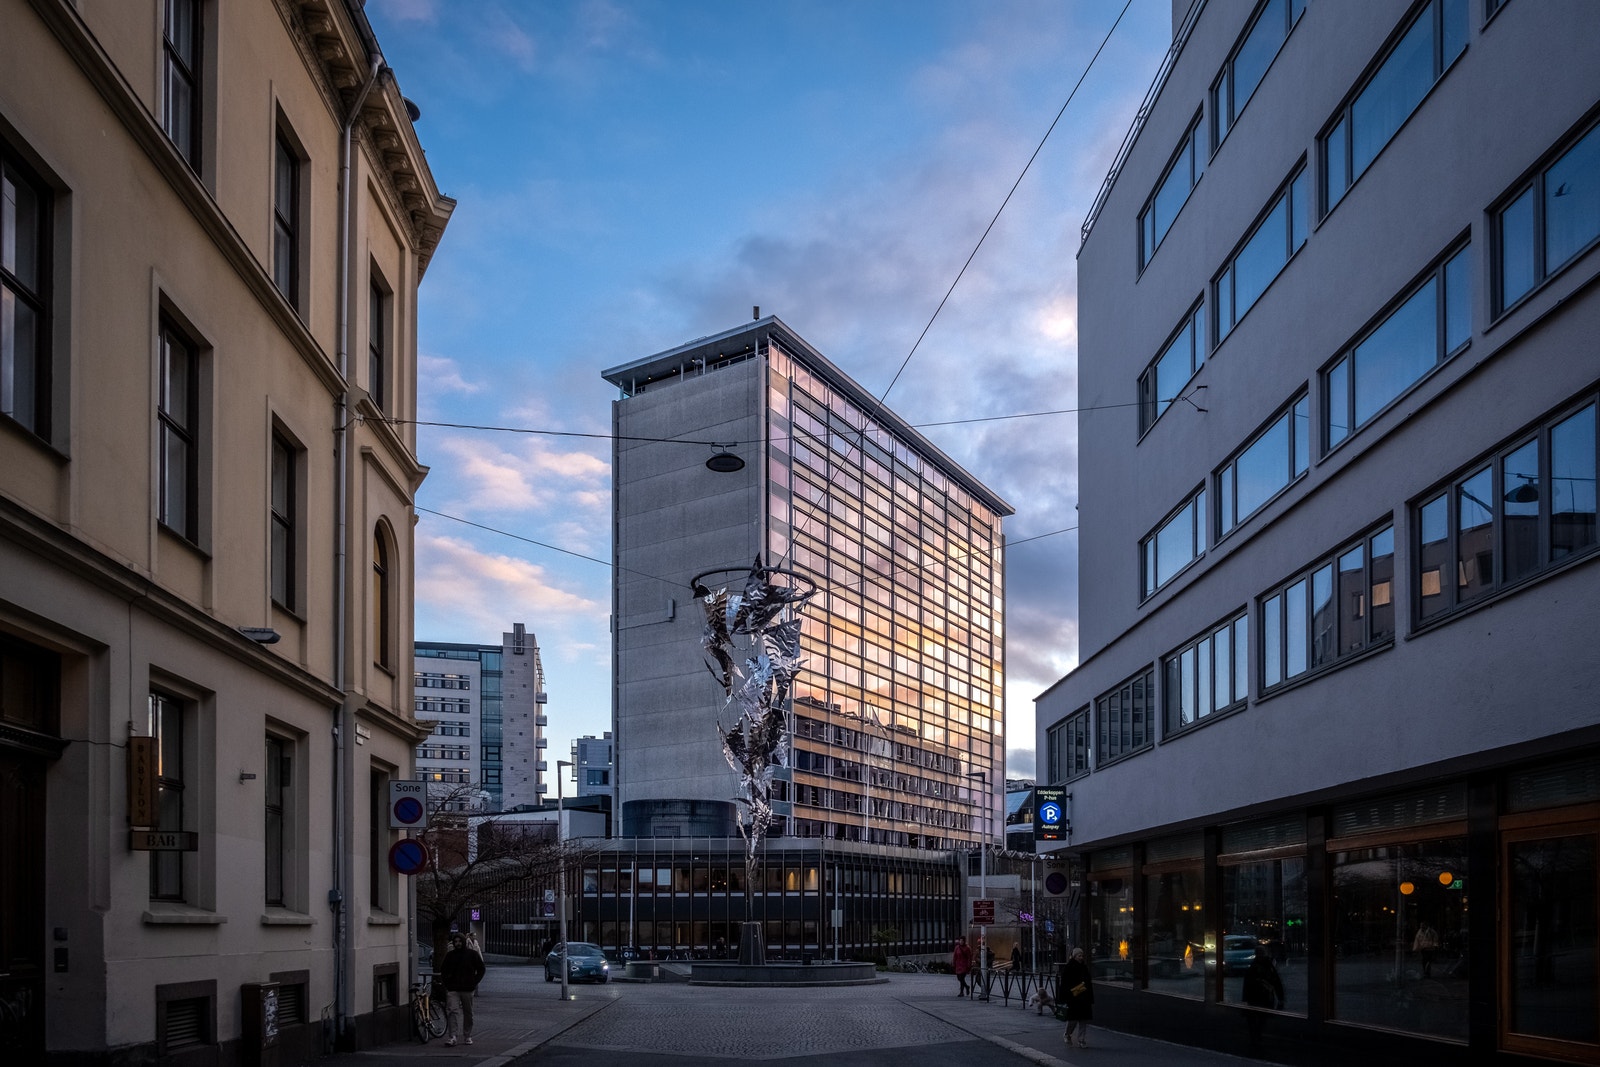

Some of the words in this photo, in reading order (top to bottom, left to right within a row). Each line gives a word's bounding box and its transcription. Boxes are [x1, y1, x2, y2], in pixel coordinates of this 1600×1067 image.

[395, 783, 421, 793] Sone
[146, 835, 175, 846] BAR
[1047, 861, 1066, 869] Sone
